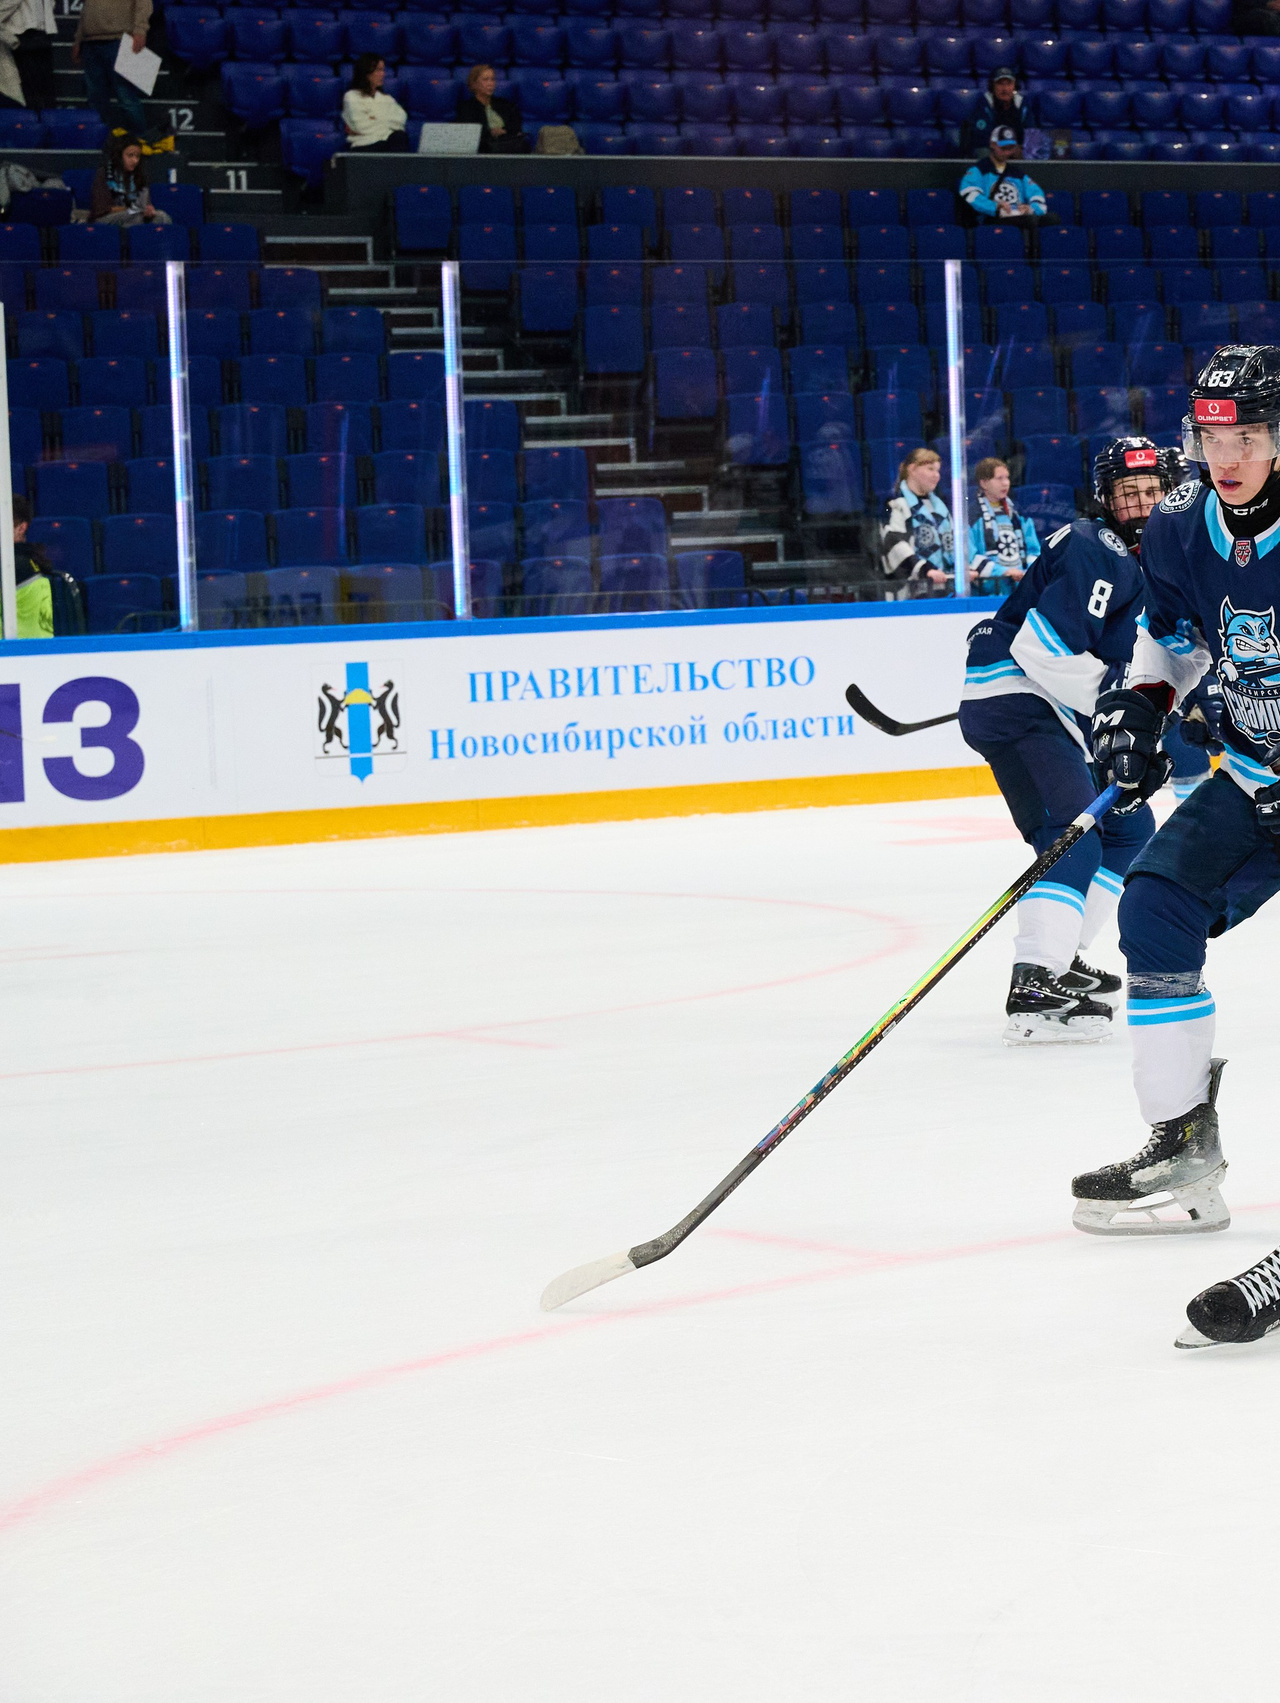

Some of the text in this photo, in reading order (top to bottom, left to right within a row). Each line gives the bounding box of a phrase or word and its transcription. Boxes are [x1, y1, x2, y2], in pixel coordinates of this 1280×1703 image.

[168, 108, 194, 130] 12
[226, 170, 247, 191] 11
[1208, 370, 1235, 387] 83
[1087, 579, 1114, 619] 8
[467, 656, 816, 703] ПРАВИТЕЛЬСТВО
[429, 712, 856, 761] Новосибирской области
